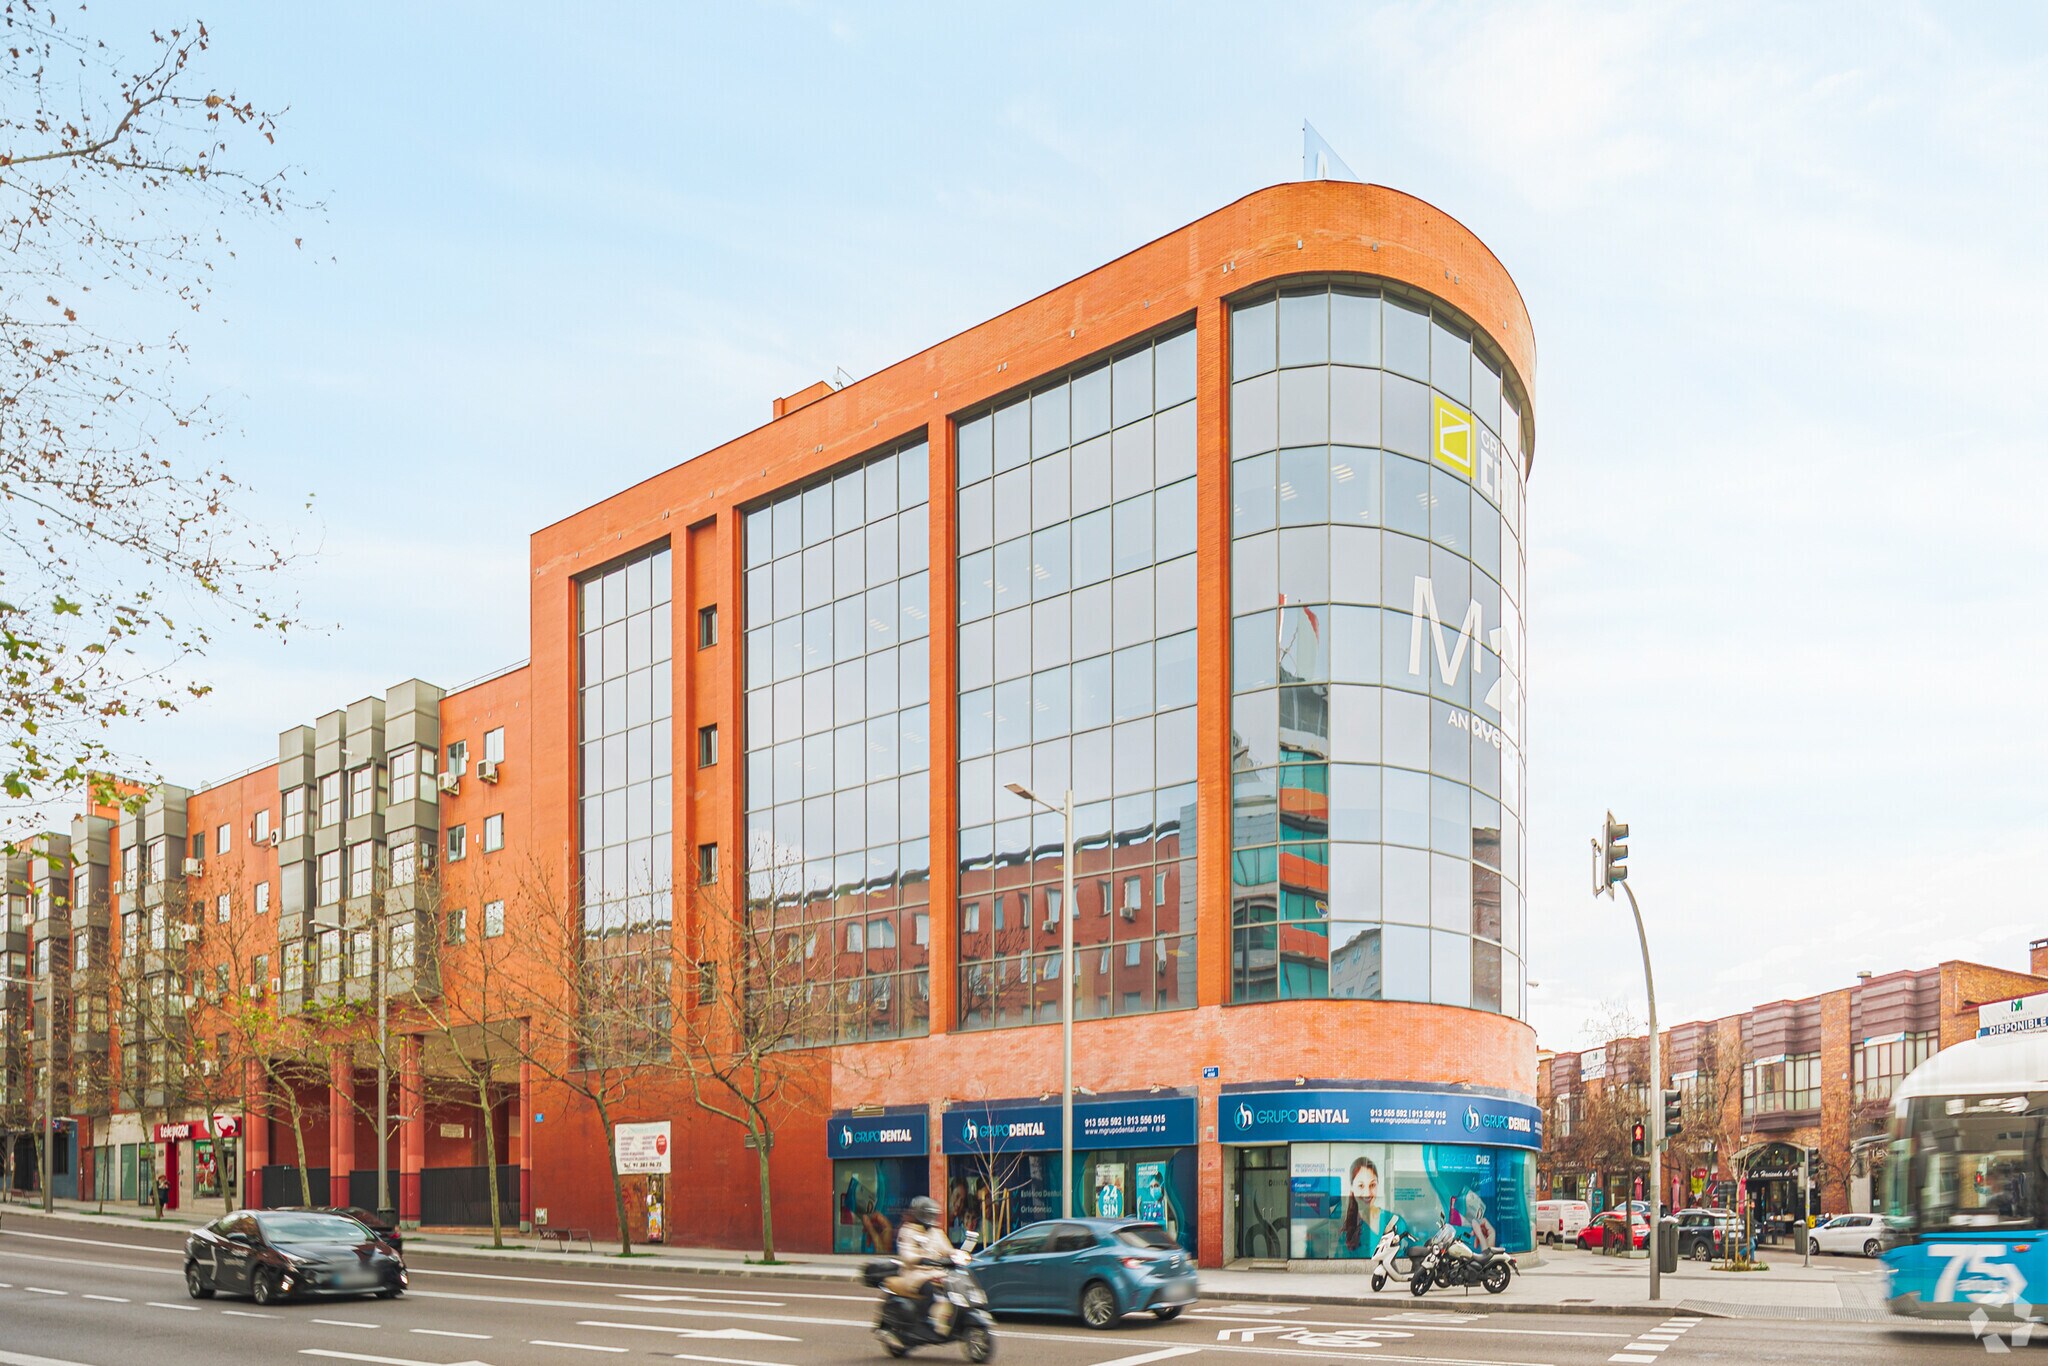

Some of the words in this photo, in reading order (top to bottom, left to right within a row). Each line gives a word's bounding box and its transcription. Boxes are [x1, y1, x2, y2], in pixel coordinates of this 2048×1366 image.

[1448, 709, 1469, 731] AN
[1989, 1016, 2047, 1036] DISPONIBLE
[1084, 1118, 1096, 1127] 913
[1127, 1115, 1139, 1125] 913
[1153, 1114, 1166, 1124] 015
[1370, 1108, 1382, 1117] 913
[1411, 1110, 1423, 1118] 913
[1435, 1110, 1447, 1119] 015
[160, 1123, 189, 1143] telepizza
[1475, 1155, 1490, 1165] DIEZ
[1103, 1185, 1118, 1200] 24
[1103, 1204, 1118, 1216] SIN
[1928, 1244, 2028, 1304] 75
